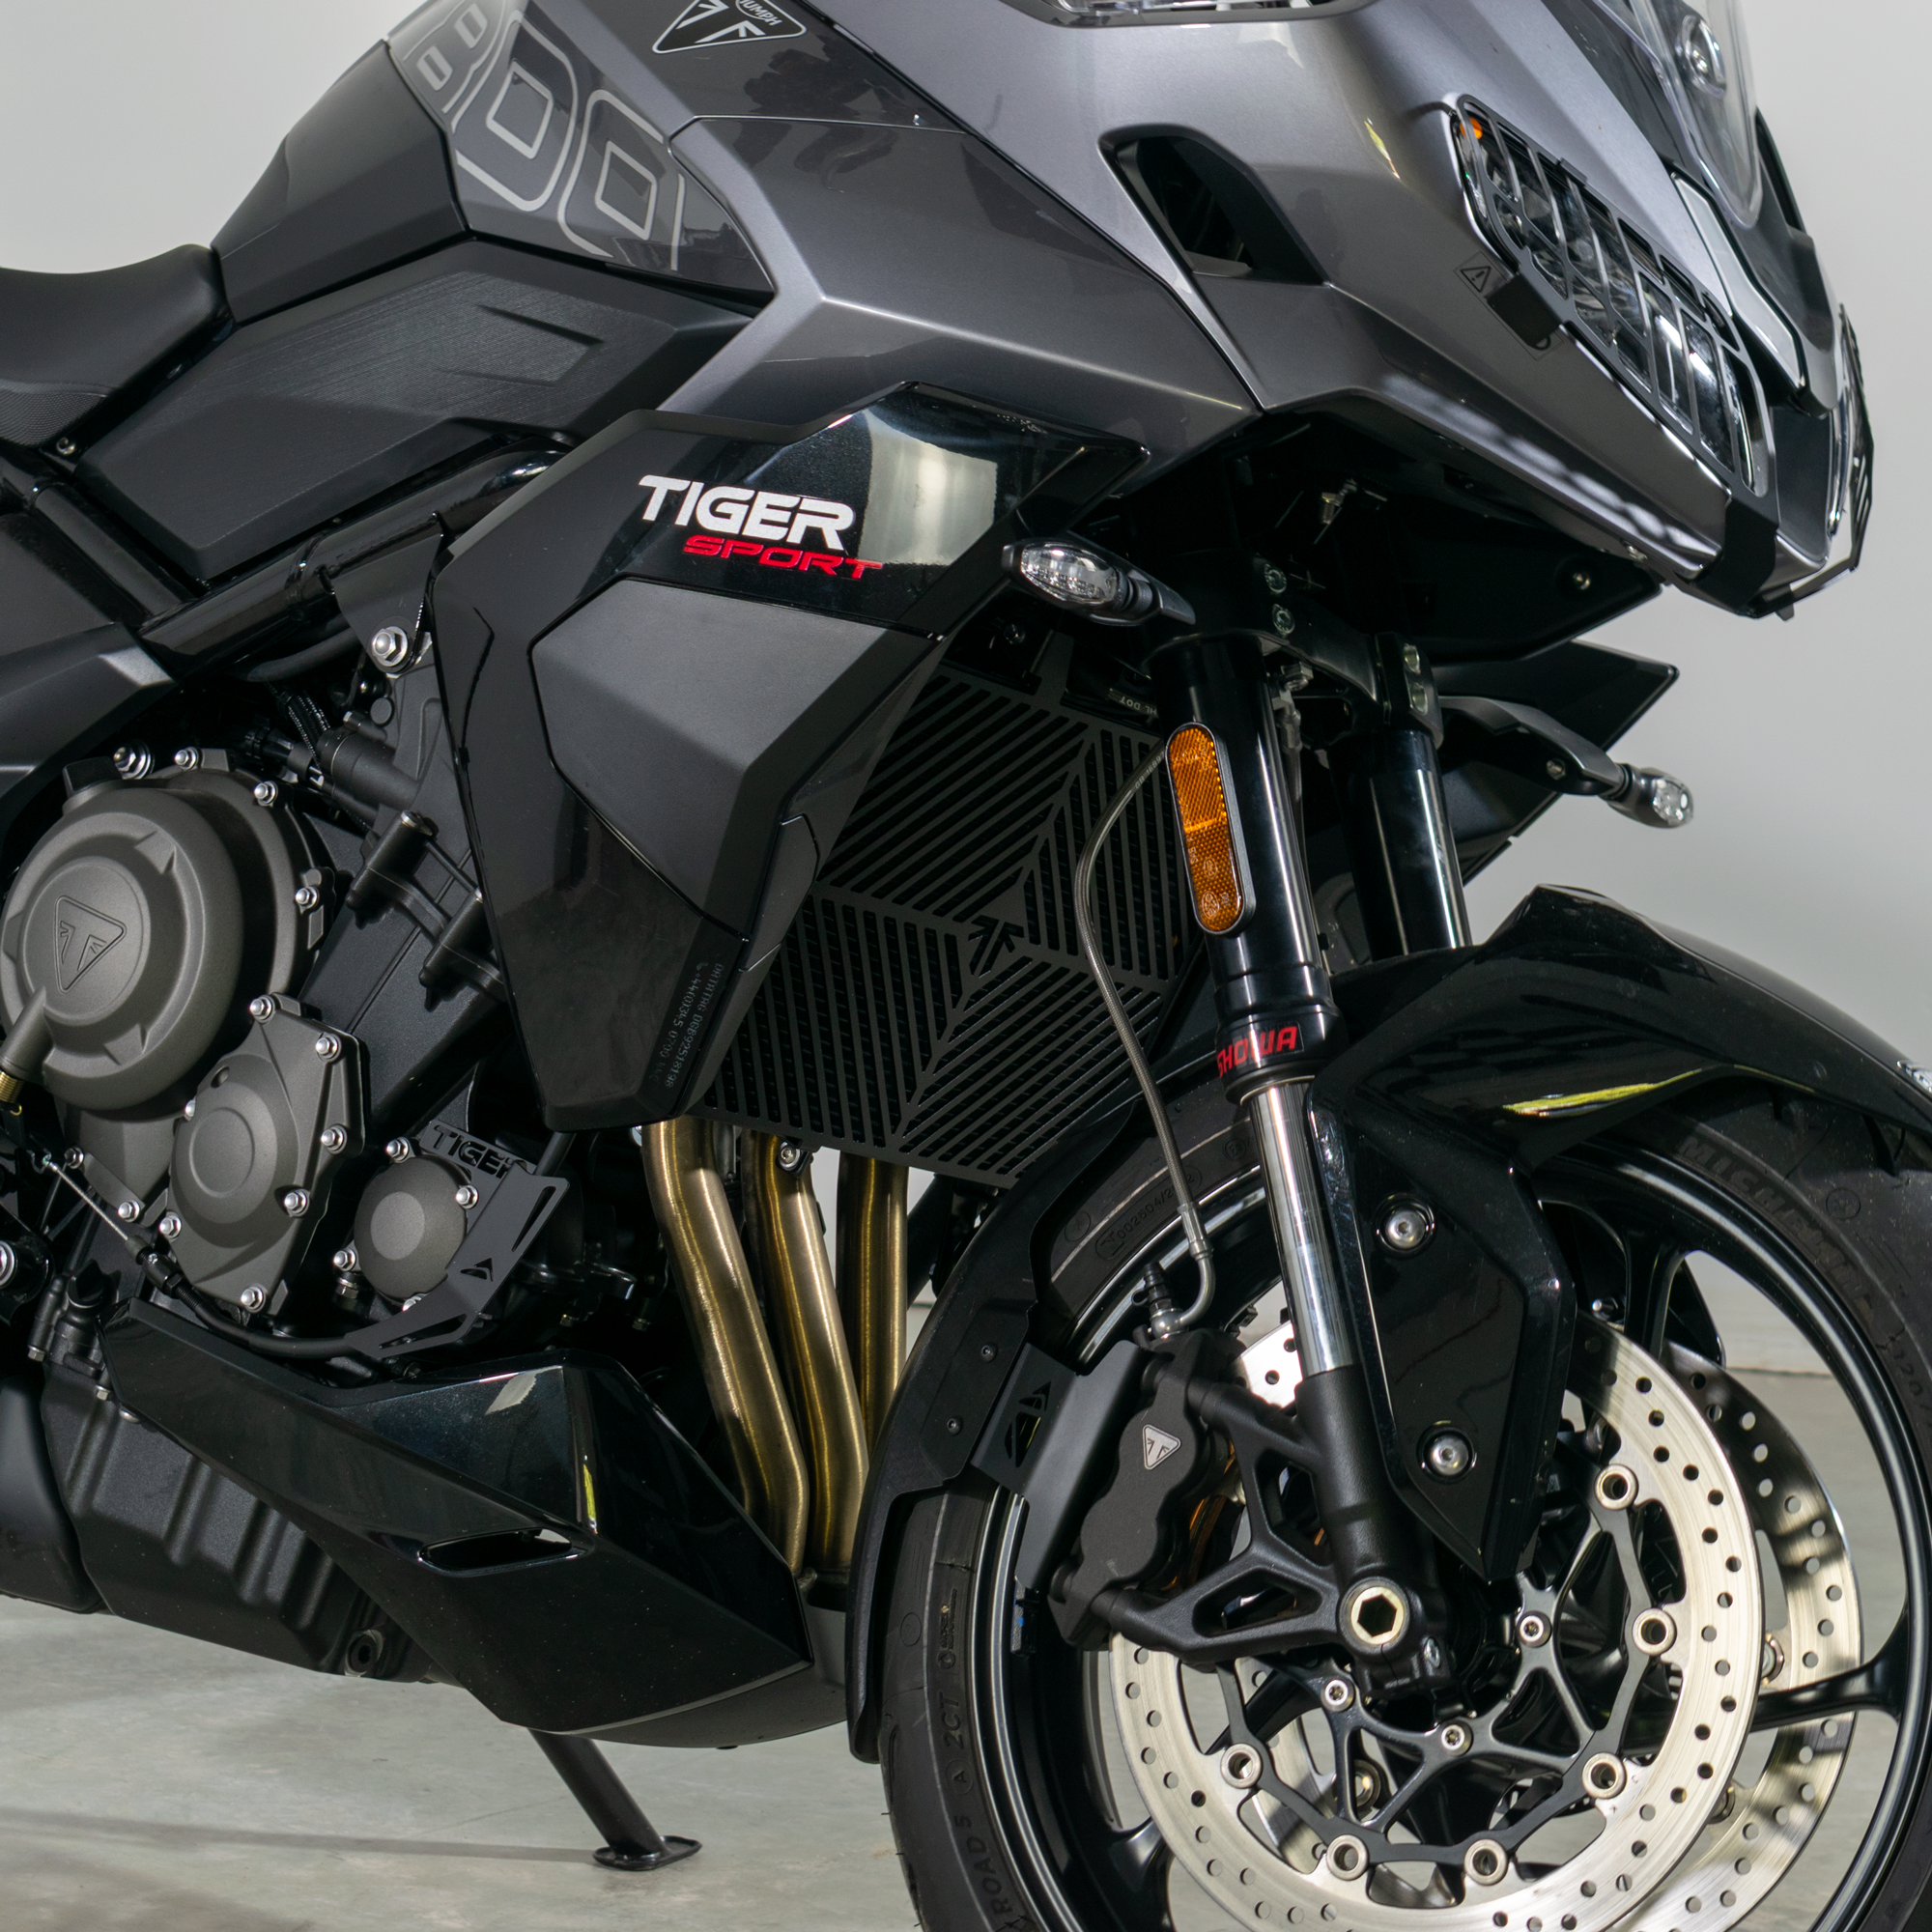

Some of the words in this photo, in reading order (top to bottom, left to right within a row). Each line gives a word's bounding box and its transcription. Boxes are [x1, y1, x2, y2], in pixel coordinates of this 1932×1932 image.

[739, 0, 782, 26] IUMPH
[639, 474, 856, 551] TIGER
[683, 534, 883, 580] SPORT
[1118, 695, 1141, 711] DOT
[696, 962, 724, 1012] DATATAG
[1217, 1025, 1297, 1078] SHOWA
[1677, 1134, 1866, 1301] MICHELIN
[939, 1690, 964, 1750] 2CT
[954, 1814, 973, 1829] 5
[966, 1835, 1013, 1916] ROAD
